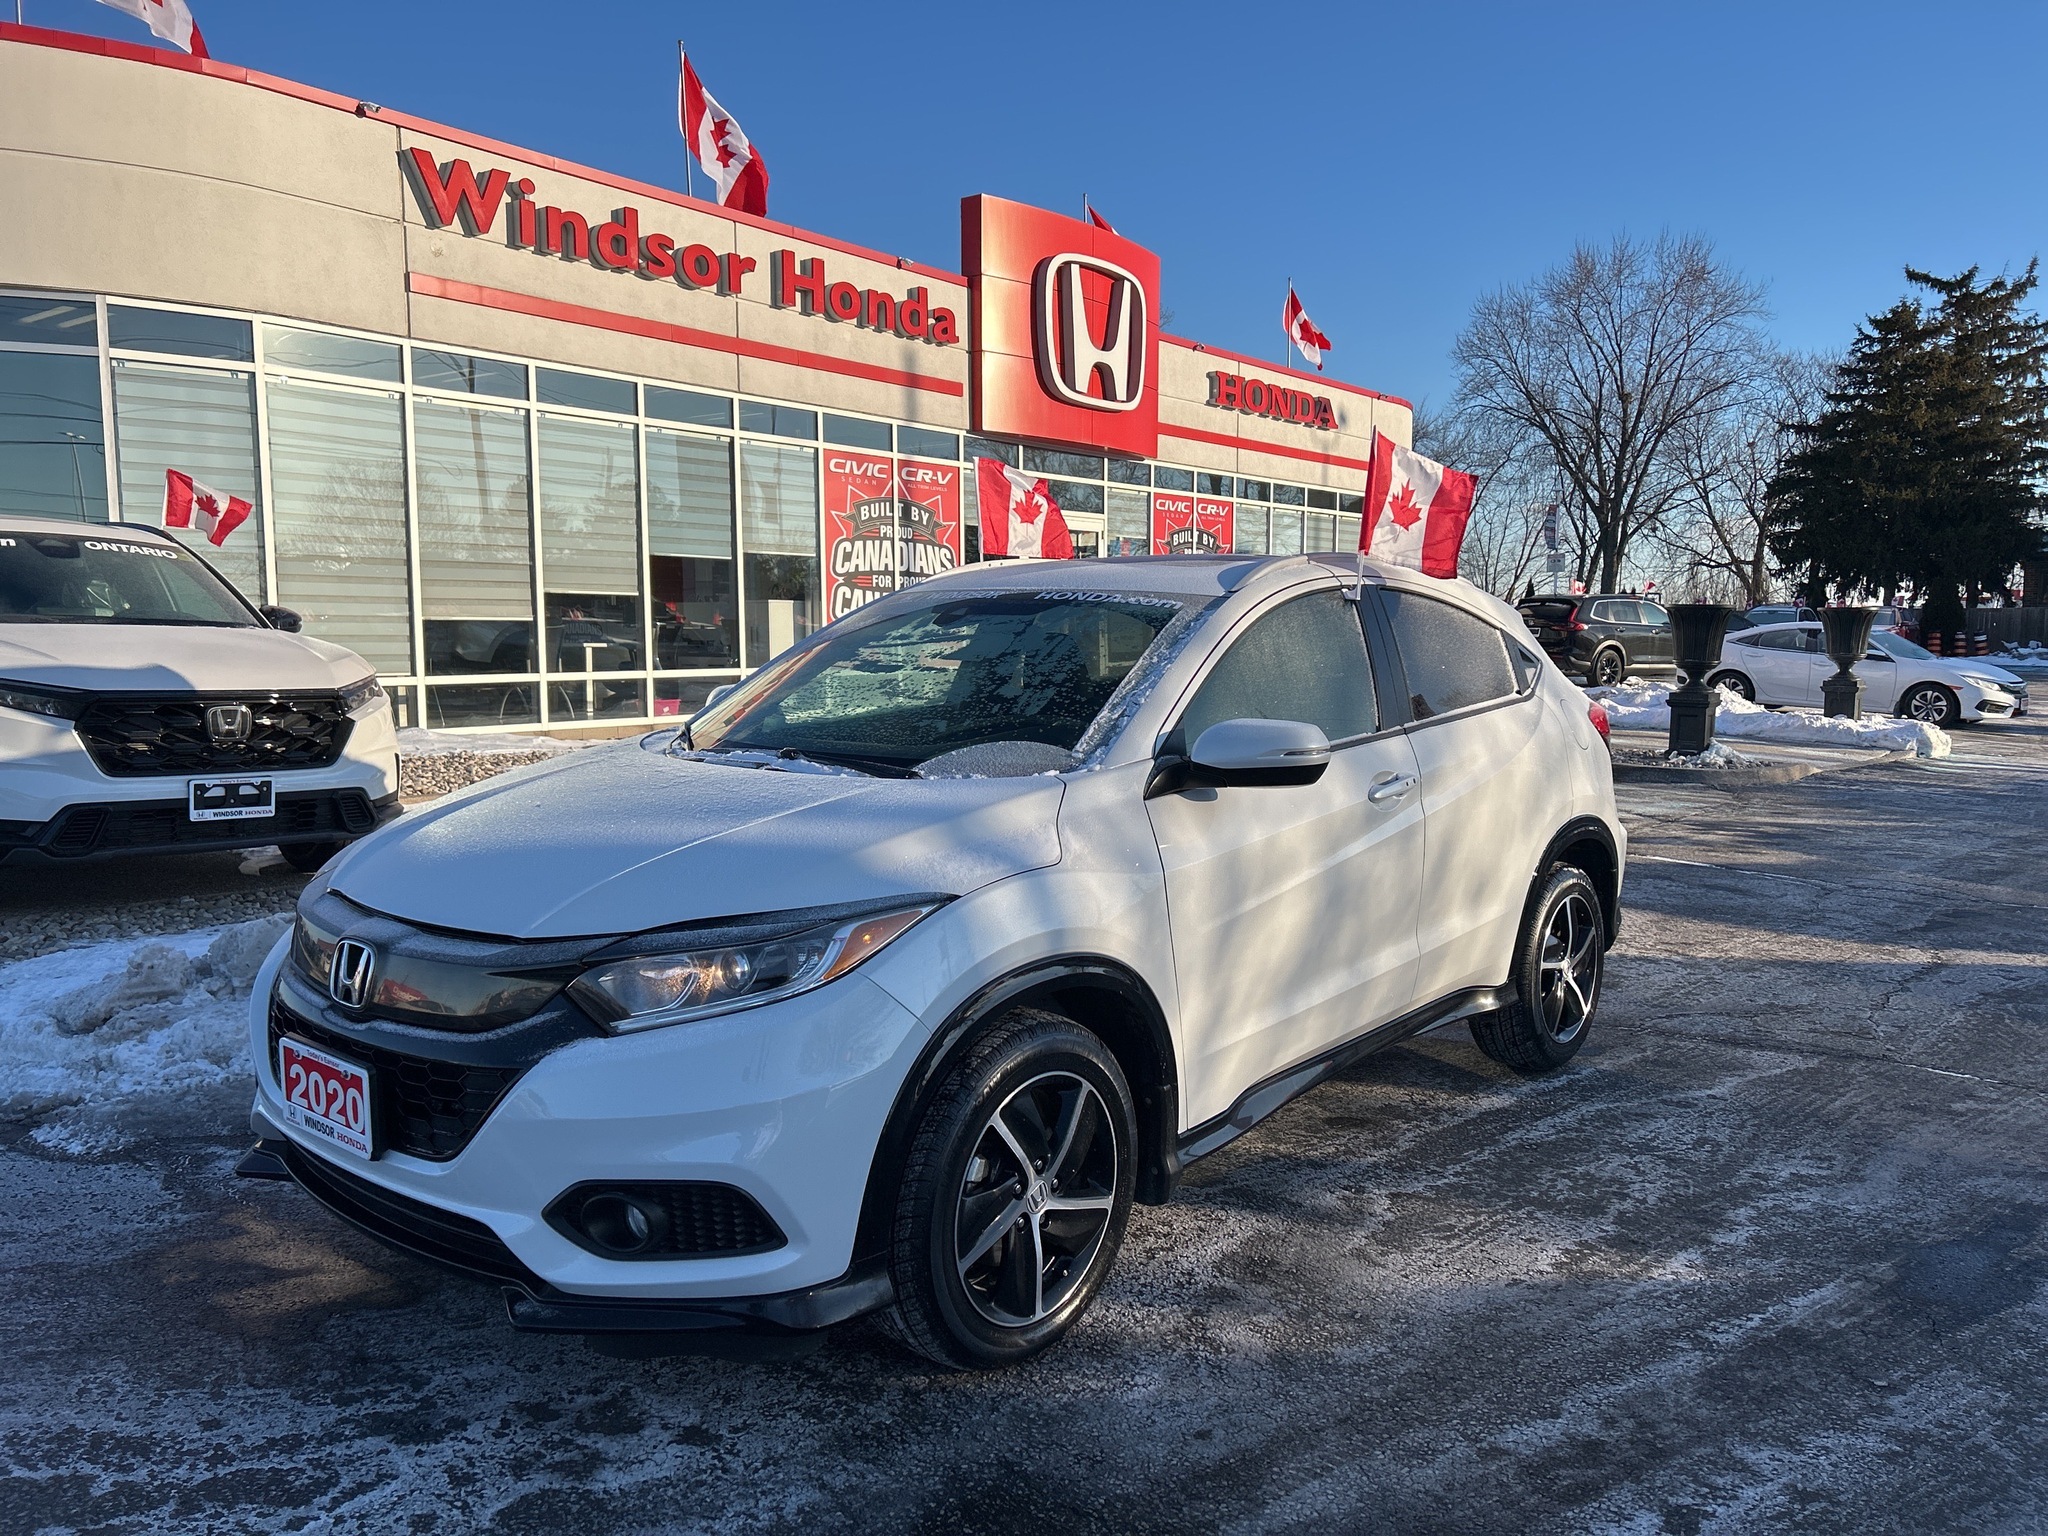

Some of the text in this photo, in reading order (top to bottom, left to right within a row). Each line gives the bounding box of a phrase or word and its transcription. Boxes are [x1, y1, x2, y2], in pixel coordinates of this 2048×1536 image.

[404, 146, 960, 344] Windsor Honda
[1212, 370, 1339, 429] HONDA
[829, 458, 889, 478] CIVIC
[901, 467, 953, 485] CR-V
[841, 476, 877, 485] SEDAN
[1156, 499, 1191, 513] CIVIC
[1198, 503, 1229, 516] CR-V
[911, 506, 930, 525] BY
[1202, 533, 1215, 548] BY
[84, 541, 179, 559] ONTARIO
[836, 540, 953, 575] CANADIANS
[872, 575, 892, 588] FOR
[213, 810, 243, 818] WINDSOR
[289, 1063, 364, 1132] 2020
[303, 1114, 368, 1154] WINDSOR HONDA
